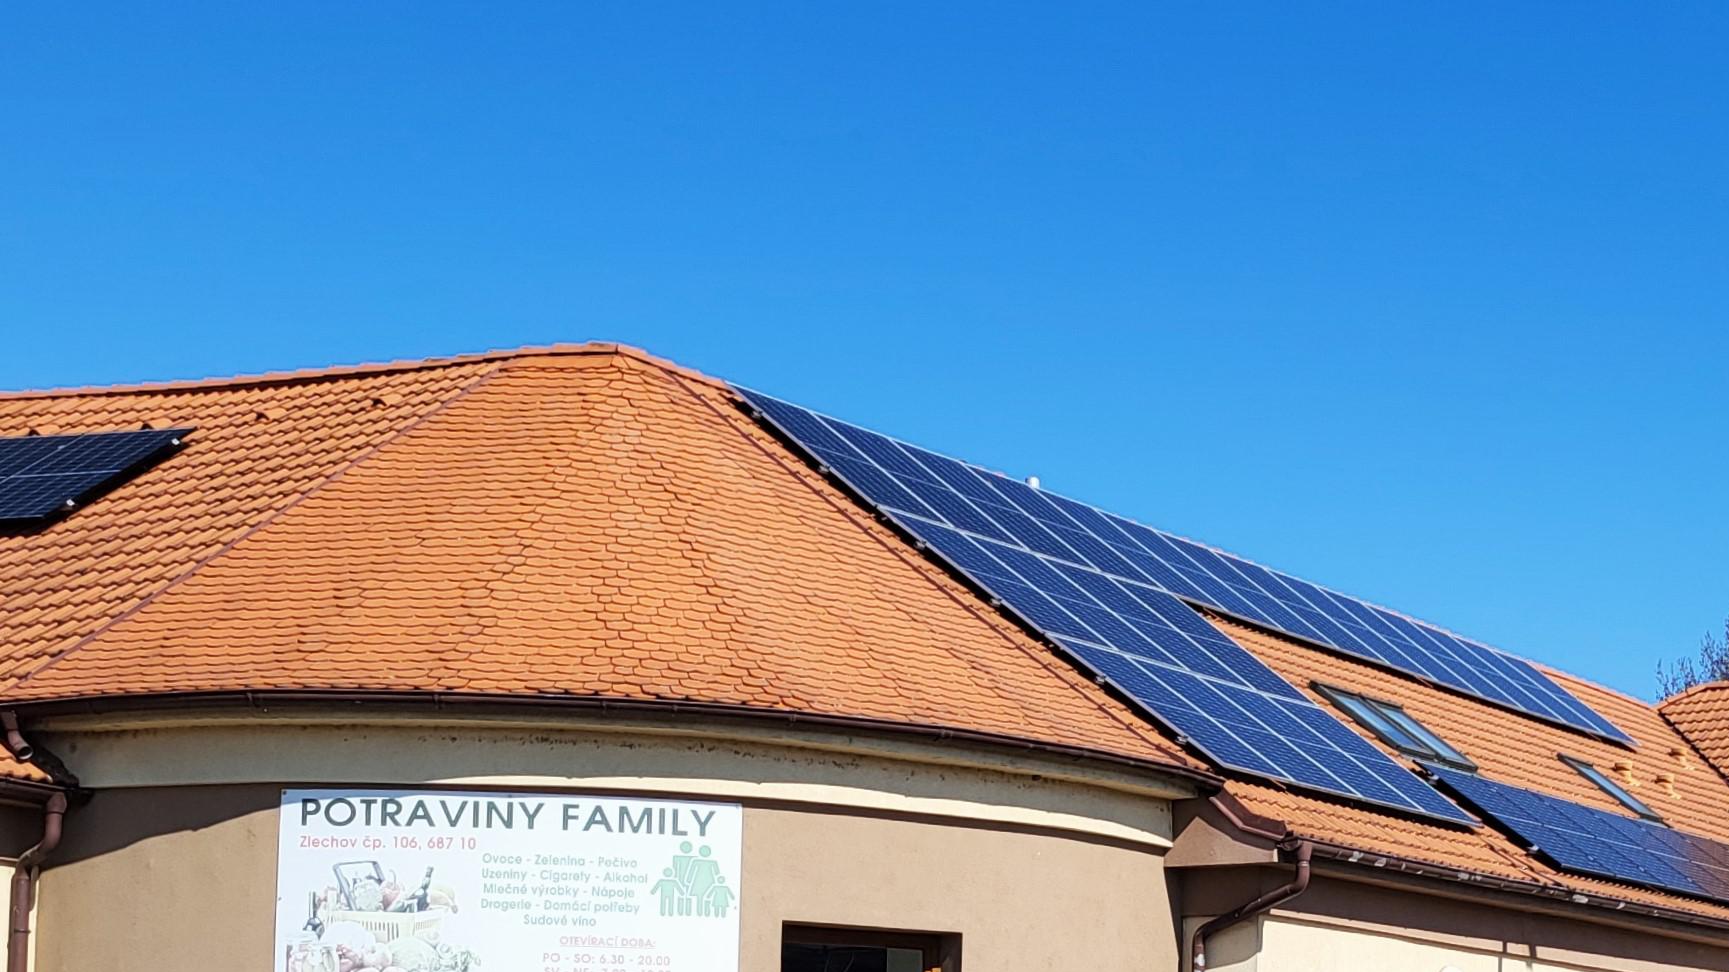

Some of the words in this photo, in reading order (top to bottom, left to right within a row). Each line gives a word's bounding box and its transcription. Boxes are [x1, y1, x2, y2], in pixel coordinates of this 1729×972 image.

[301, 798, 545, 829] POTRAVINY
[561, 803, 716, 837] FAMILY
[300, 835, 357, 848] Zlechov
[362, 836, 386, 851] čp.
[392, 836, 422, 851] 106,
[427, 837, 453, 850] 687
[460, 837, 477, 850] 10
[482, 853, 523, 865] Ovoce
[534, 854, 586, 867] Zelenina
[598, 856, 638, 868] Pečivo
[481, 868, 527, 881] Uzeniny
[540, 869, 591, 883] Cigarety
[603, 872, 648, 883] Alkohol
[483, 883, 528, 895] Mlečné
[531, 884, 580, 897] výrobky
[591, 886, 635, 899] Nápoje
[480, 898, 532, 912] Drogerie
[543, 900, 592, 912] Domácí
[594, 901, 640, 915] potřeby
[523, 914, 568, 926] Sudové
[572, 915, 597, 927] víno
[542, 952, 561, 963] PO
[574, 953, 595, 964] SO:
[599, 954, 625, 965] 6.30
[638, 955, 671, 966] 20.00
